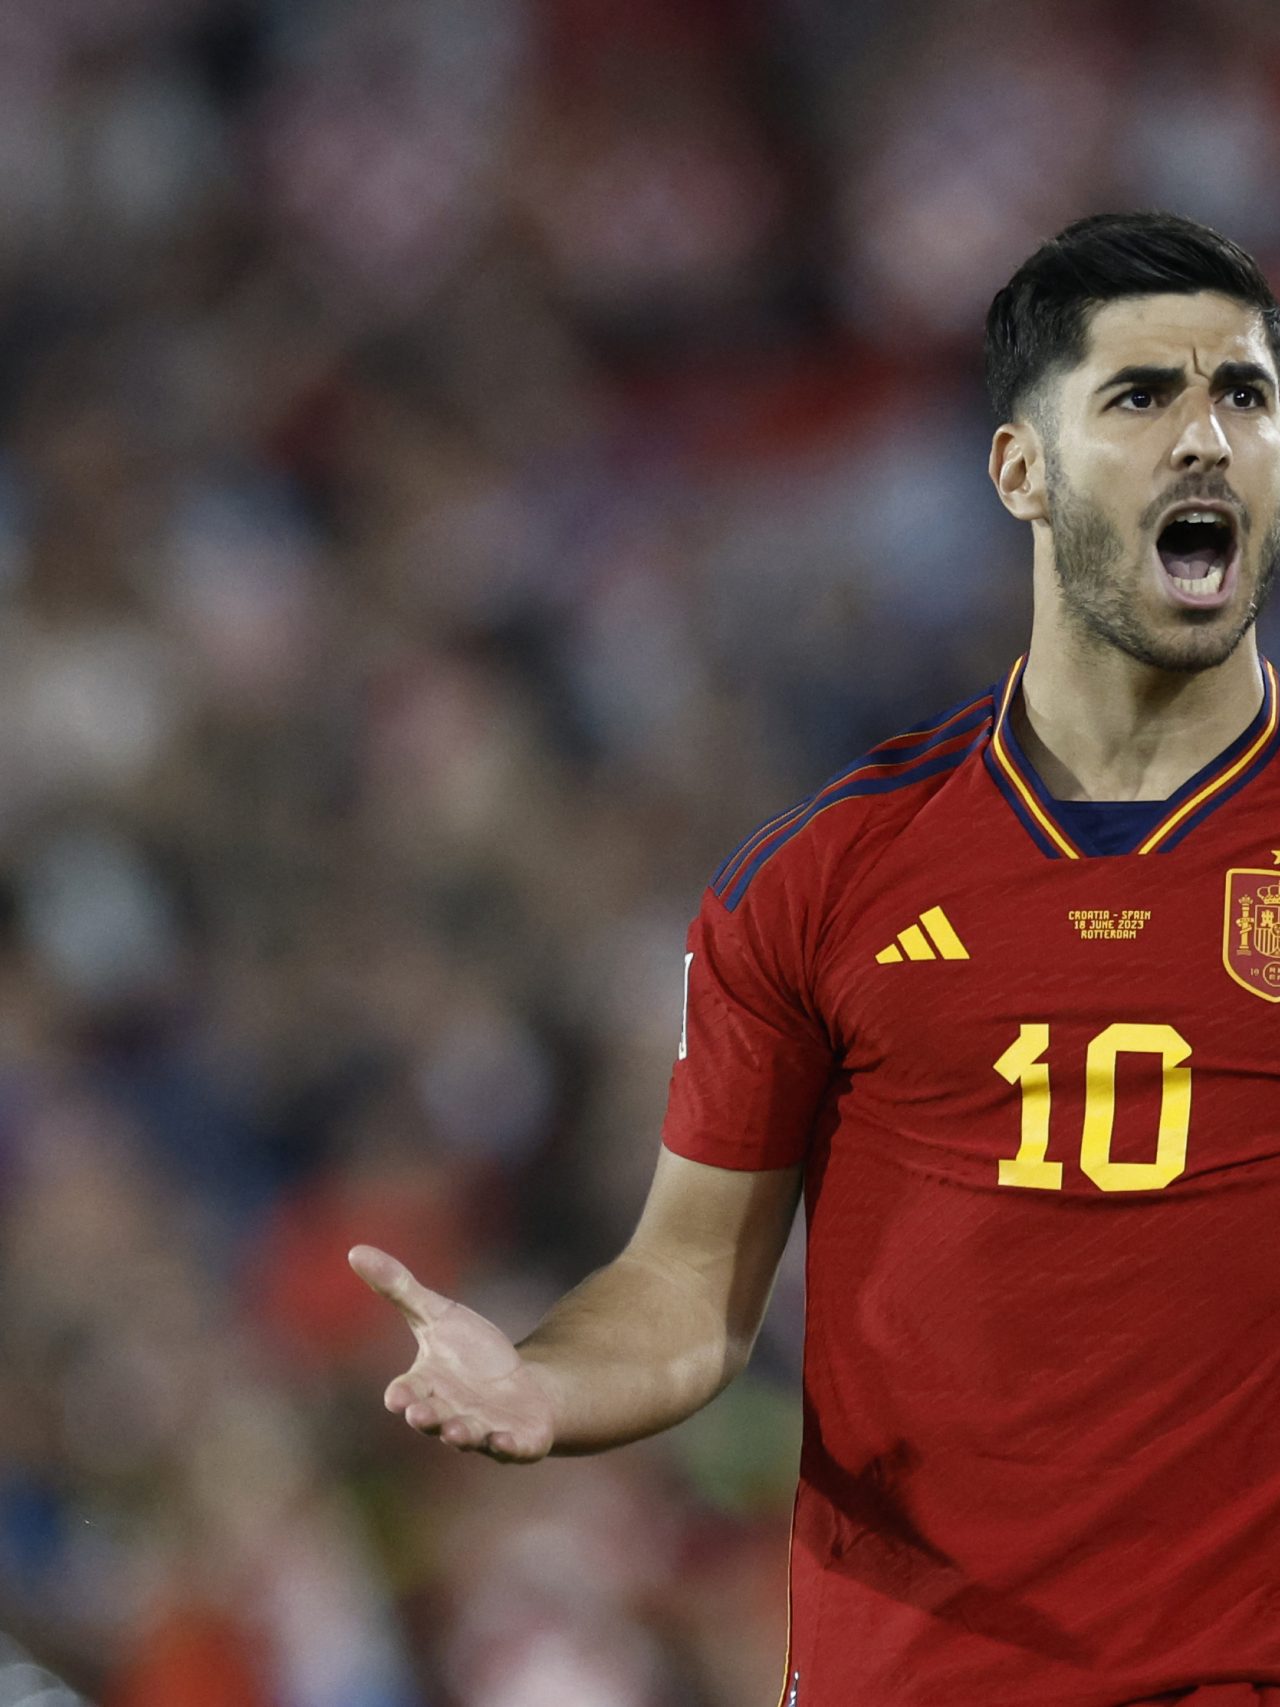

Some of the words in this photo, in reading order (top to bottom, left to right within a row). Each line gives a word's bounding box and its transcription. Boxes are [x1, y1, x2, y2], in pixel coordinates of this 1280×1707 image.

[1068, 910, 1110, 920] CROATIA
[1121, 910, 1152, 920] SPAIN
[1074, 920, 1086, 929] 18
[1089, 920, 1114, 929] JUNE
[1118, 920, 1144, 929] 2023
[1081, 929, 1136, 939] ROTTERDAM
[992, 1023, 1193, 1192] 10
